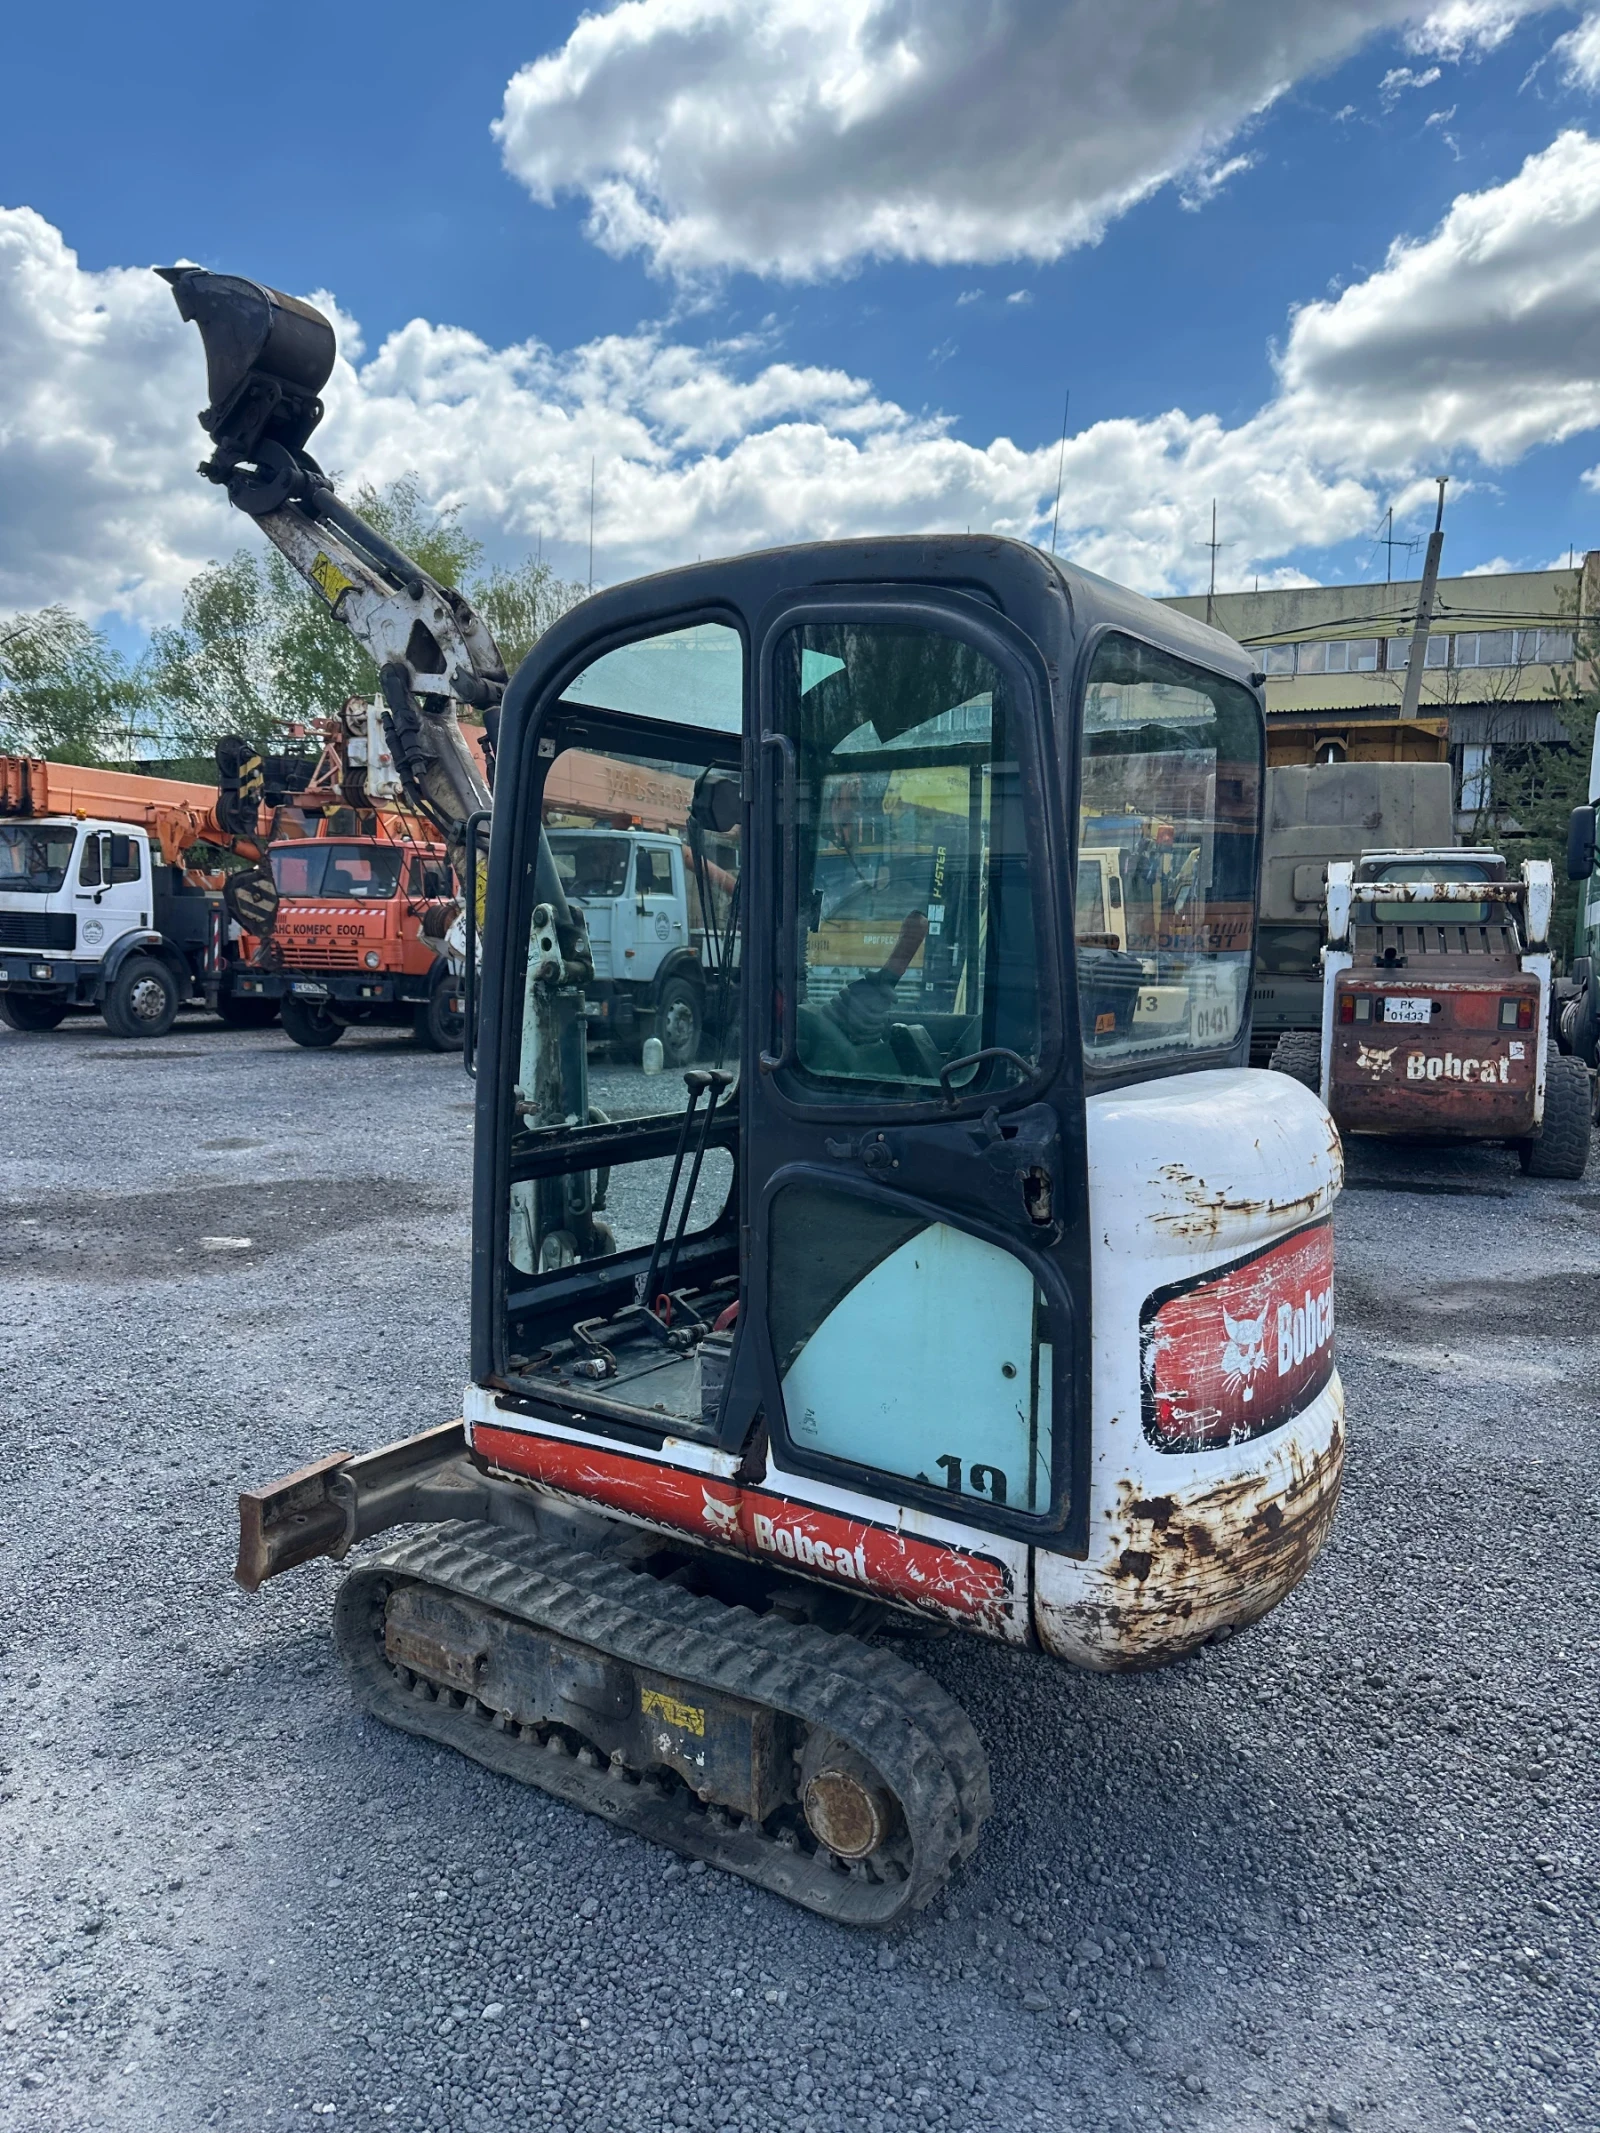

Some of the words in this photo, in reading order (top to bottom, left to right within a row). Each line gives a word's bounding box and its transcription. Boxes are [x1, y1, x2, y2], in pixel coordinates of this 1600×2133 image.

[932, 846, 947, 899] HYSTER
[293, 924, 332, 936] КОМЕРС
[337, 925, 365, 937] ЕООД
[1390, 1011, 1424, 1021] 01433
[1400, 1000, 1415, 1009] PK
[1407, 1052, 1510, 1084] Bobcat
[1277, 1286, 1333, 1378] Bobca
[752, 1512, 869, 1583] Bobcat
